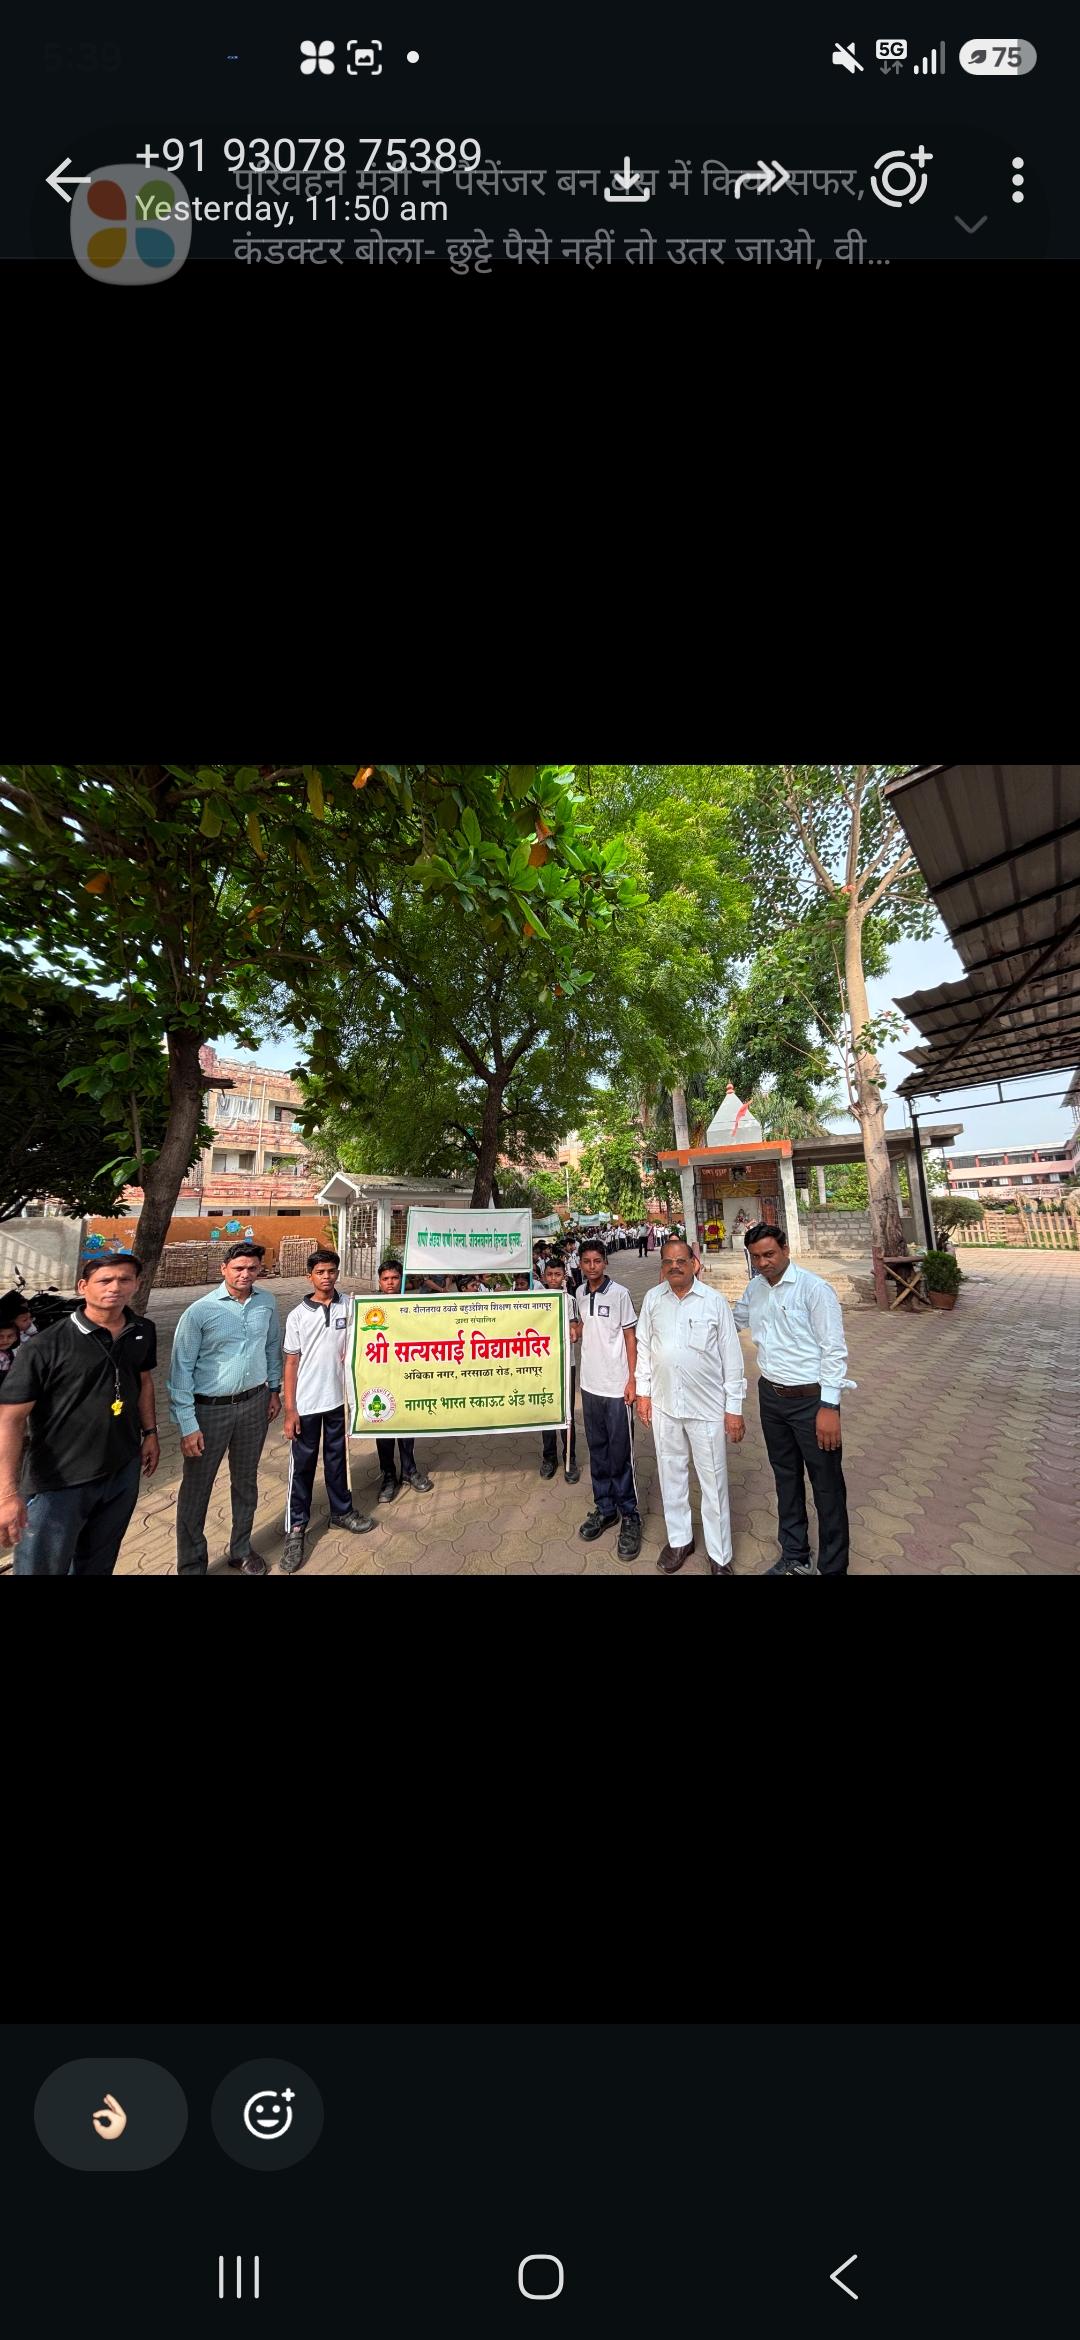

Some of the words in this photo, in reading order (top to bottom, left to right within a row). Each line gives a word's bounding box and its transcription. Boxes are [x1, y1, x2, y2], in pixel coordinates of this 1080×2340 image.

[490, 1301, 511, 1312] शिक्षण
[513, 1301, 530, 1311] संस्था
[531, 1302, 552, 1312] नागपूर
[470, 1315, 496, 1324] संचालित
[365, 1332, 389, 1364] श्री
[394, 1329, 465, 1365] सत्यसाई
[470, 1328, 551, 1360] विद्यामंदिर
[404, 1368, 434, 1380] अंबिका
[436, 1370, 458, 1380] नगर,
[460, 1368, 493, 1379] नरसाळा
[496, 1365, 513, 1377] रोड,
[515, 1366, 543, 1378] नागपूर
[404, 1398, 437, 1415] नागपूर
[440, 1396, 467, 1410] भारत
[469, 1395, 504, 1408] स्काऊट
[528, 1387, 554, 1408] गाईड
